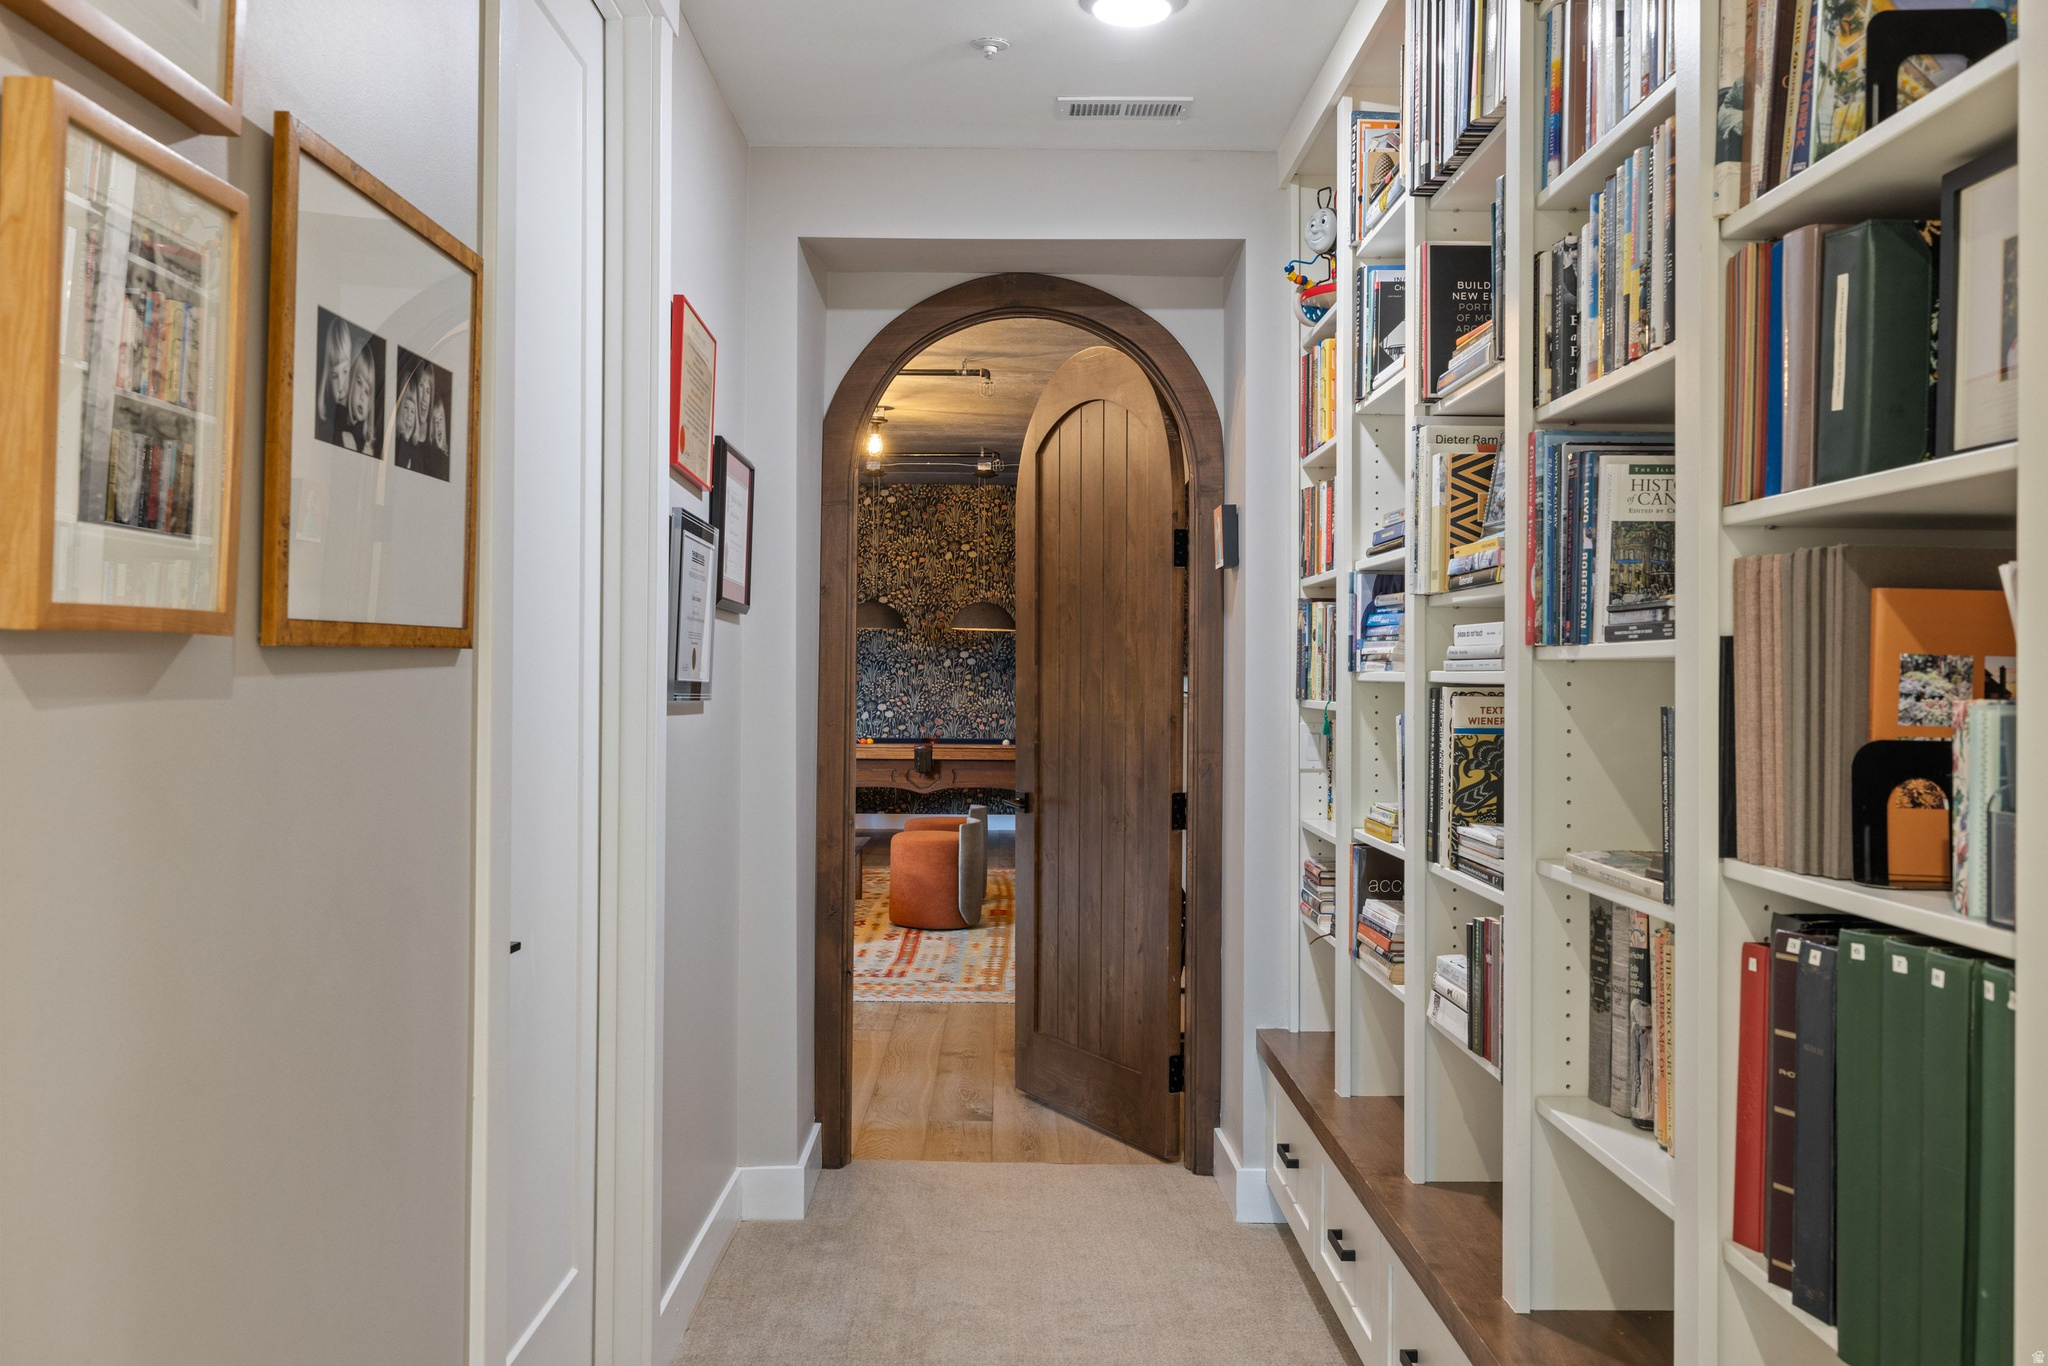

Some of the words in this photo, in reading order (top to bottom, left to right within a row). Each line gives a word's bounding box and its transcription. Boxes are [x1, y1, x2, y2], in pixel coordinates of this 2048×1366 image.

[1804, 16, 1818, 75] NEW
[1795, 77, 1813, 148] YORK
[1457, 281, 1491, 290] BUILD
[1452, 292, 1478, 300] NEW
[1457, 314, 1470, 322] OF
[1435, 434, 1470, 444] Dieter
[1473, 435, 1498, 444] Ram
[1631, 478, 1675, 492] HIST
[1626, 493, 1637, 505] of
[1580, 552, 1588, 628] ROBERTSON
[1480, 706, 1504, 715] TEXT
[1368, 879, 1404, 893] acc
